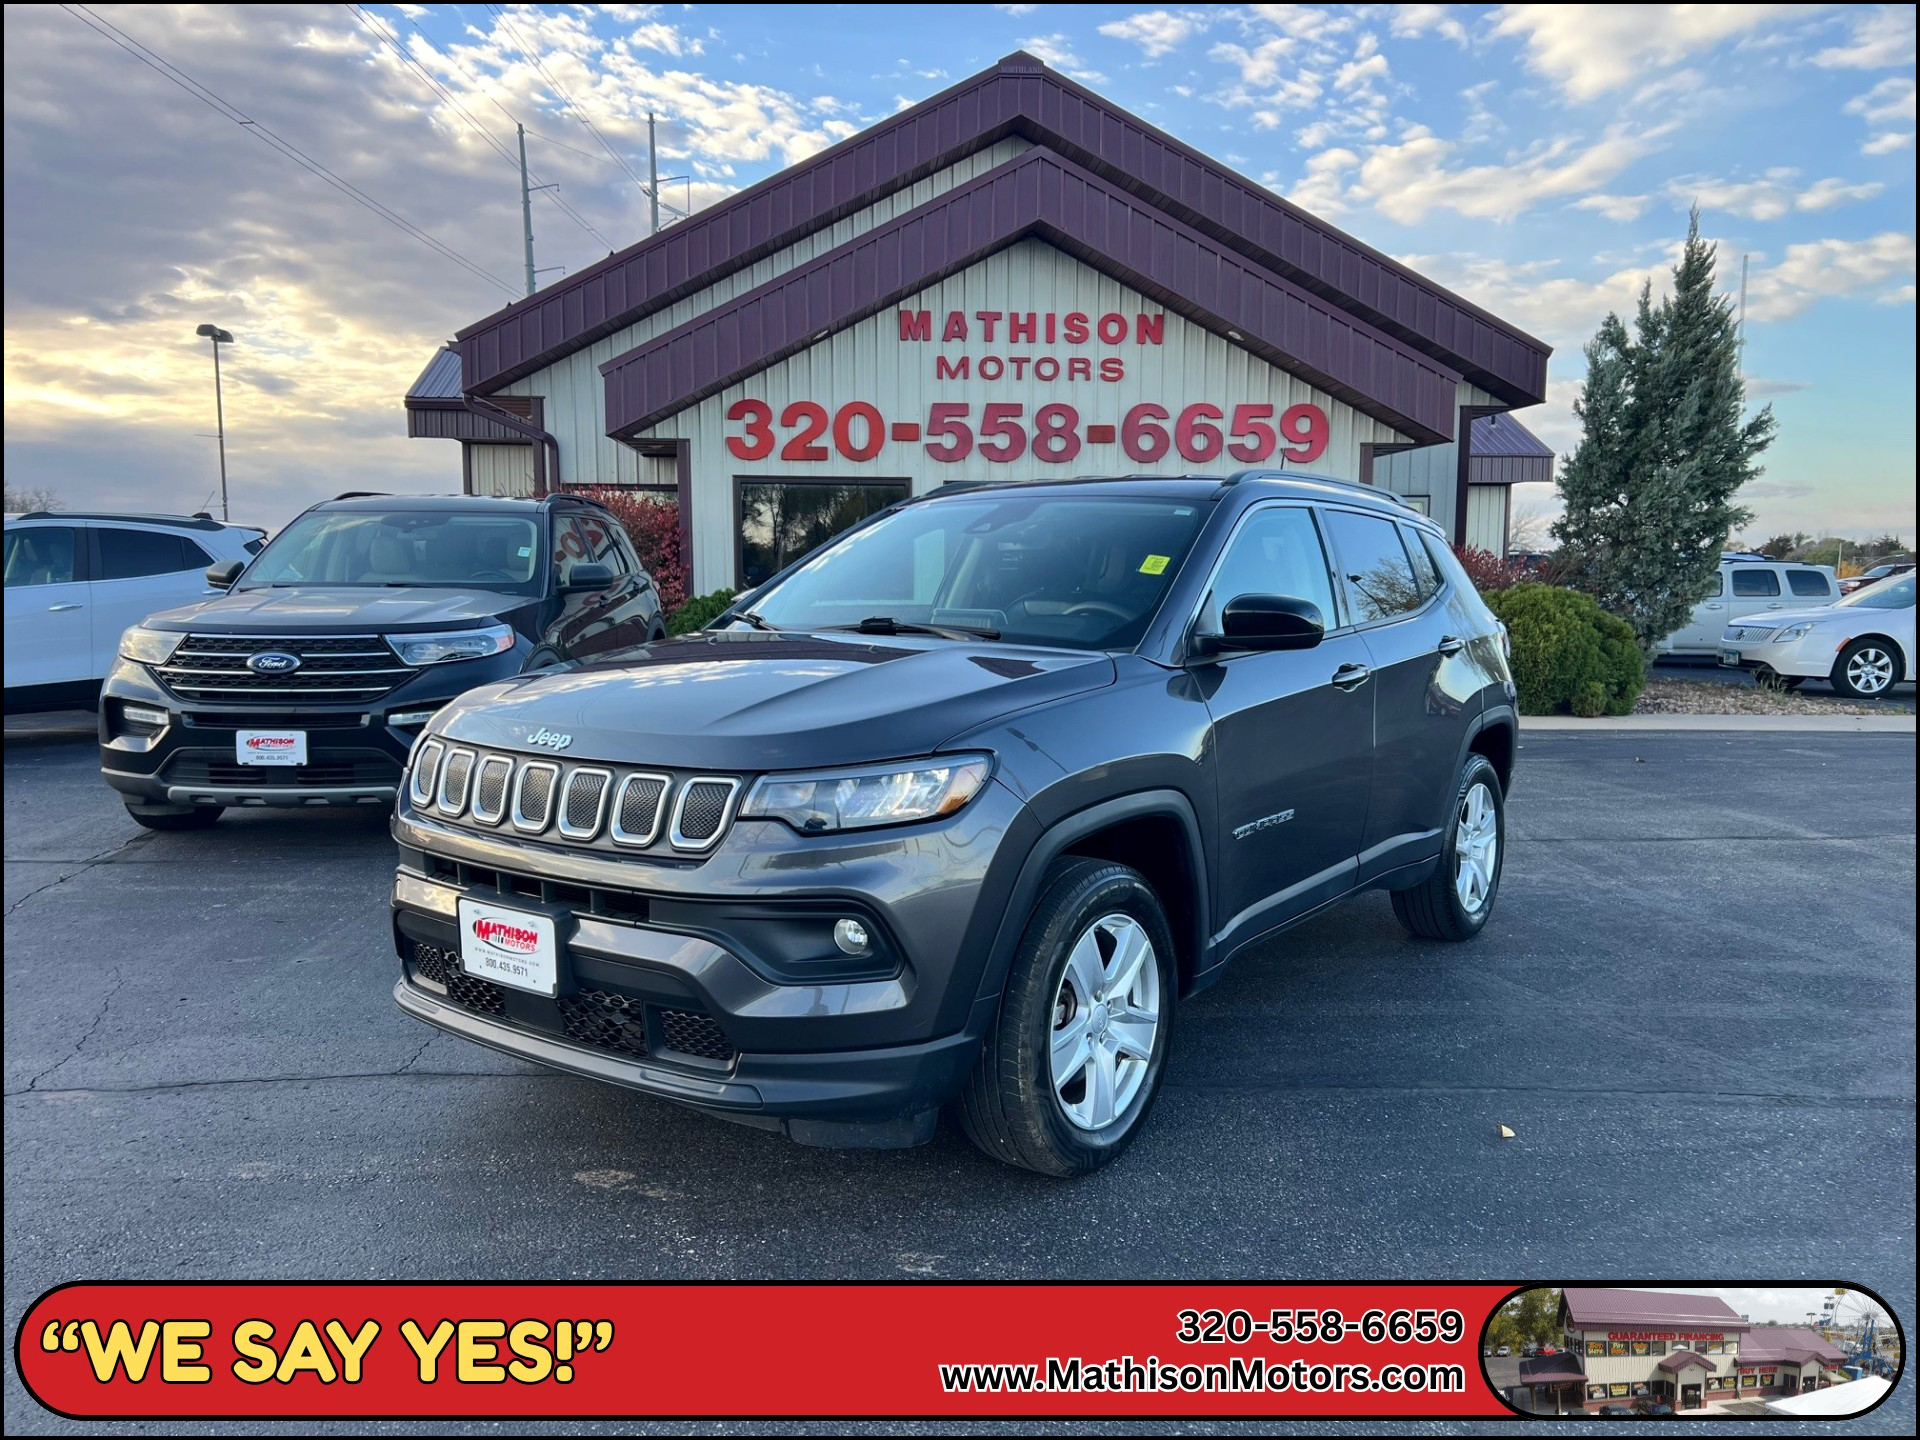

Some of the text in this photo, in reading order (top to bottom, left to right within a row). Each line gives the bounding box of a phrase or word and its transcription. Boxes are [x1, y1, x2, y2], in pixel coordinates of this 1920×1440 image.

[899, 309, 1164, 346] MATHISON
[936, 355, 1126, 383] MOTORS
[725, 398, 1330, 465] 320-558-6659
[258, 656, 287, 669] Ford
[249, 738, 295, 748] MATHISON
[526, 727, 573, 752] Jeep
[476, 919, 538, 945] MATHISON
[504, 938, 536, 952] MOTORS
